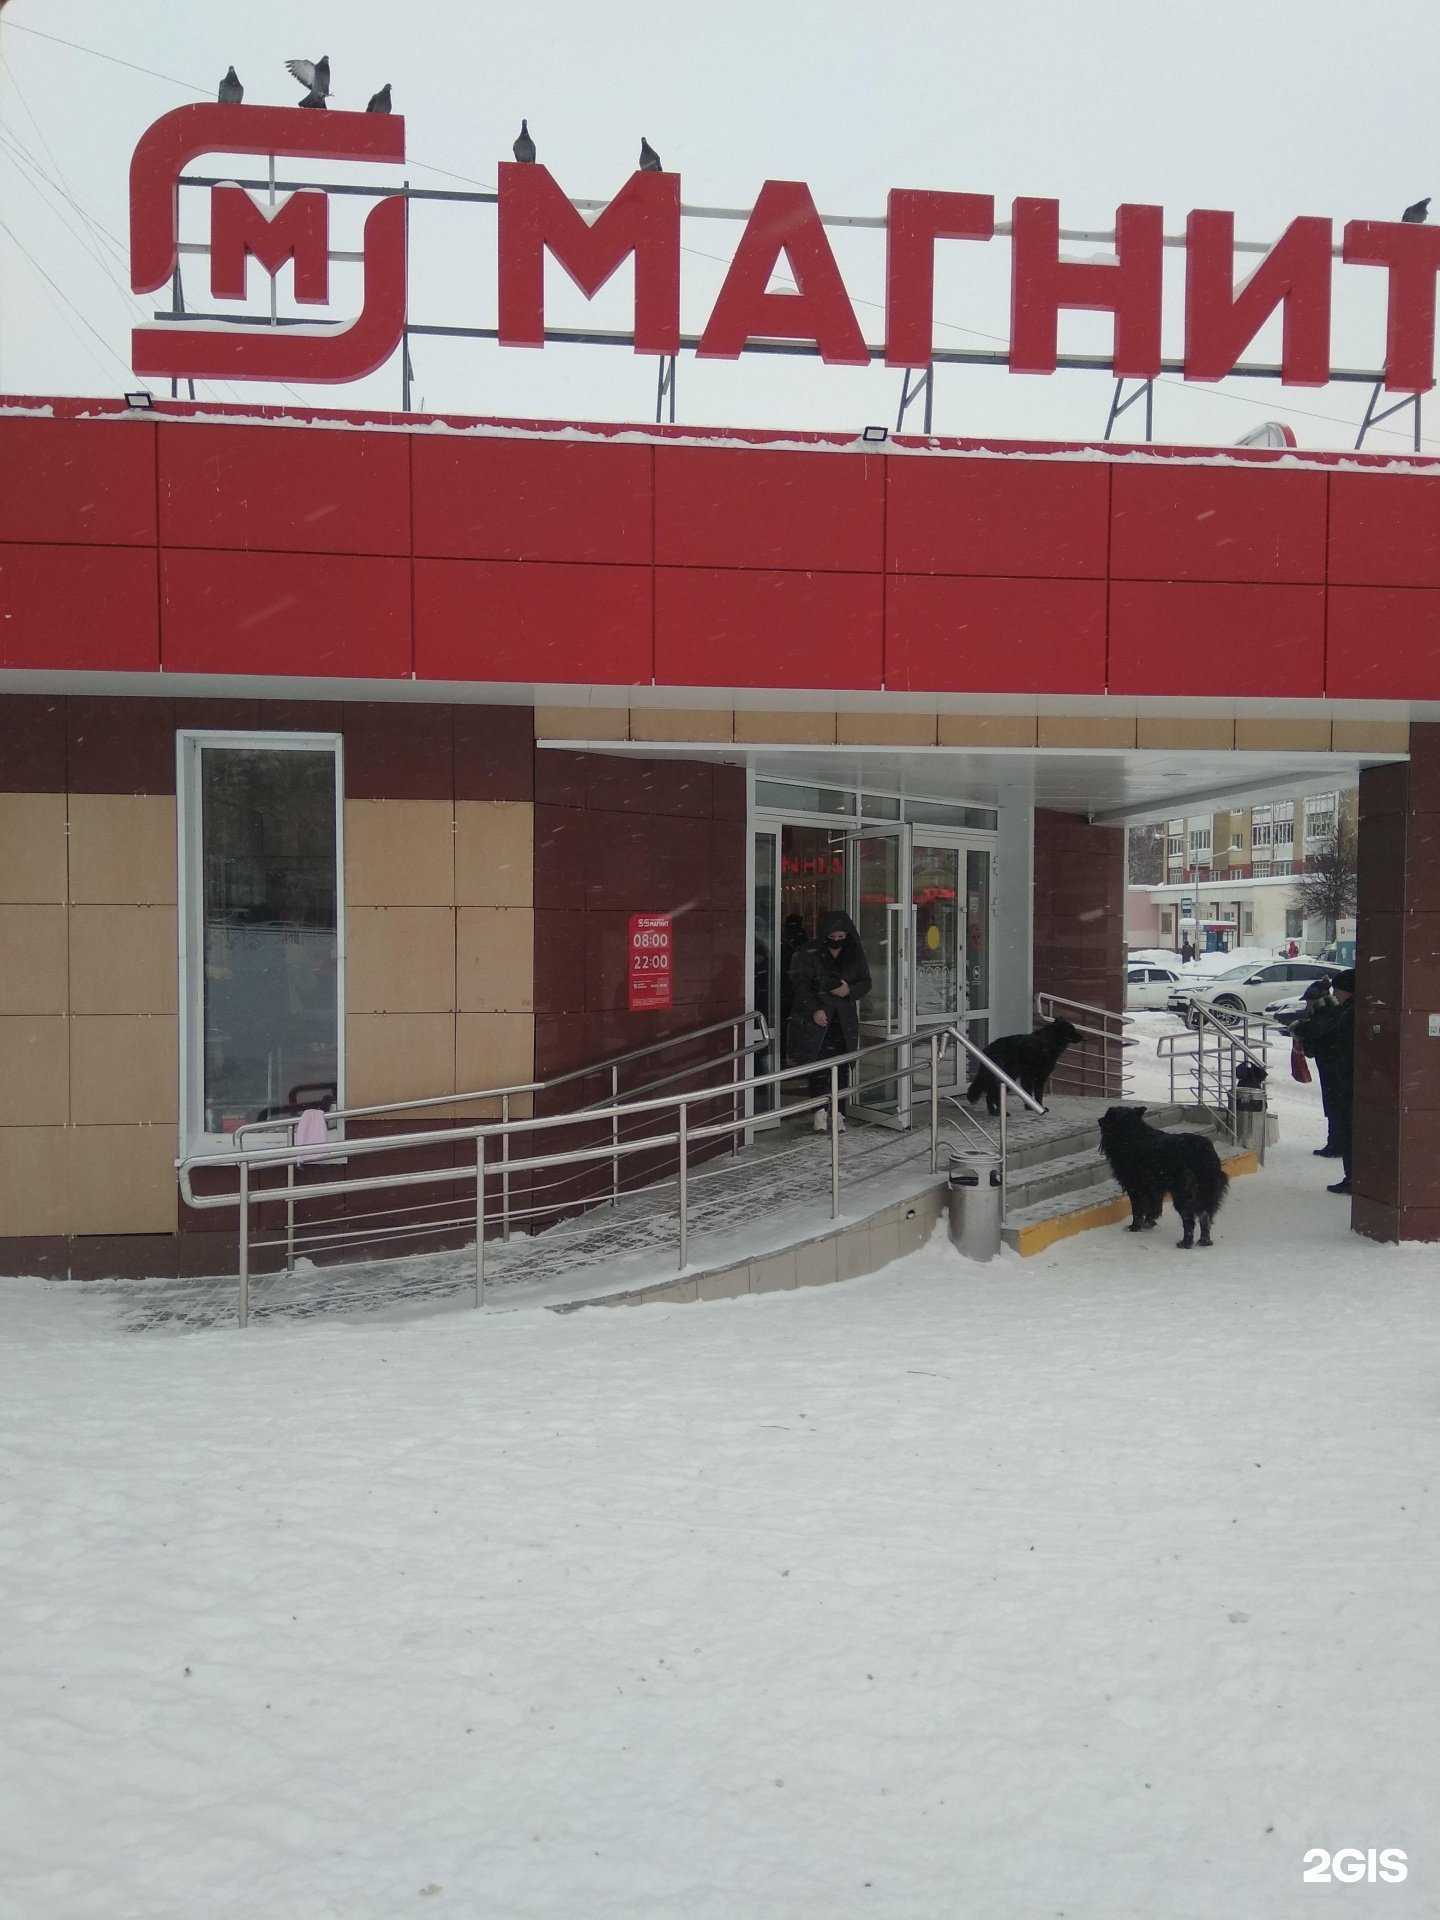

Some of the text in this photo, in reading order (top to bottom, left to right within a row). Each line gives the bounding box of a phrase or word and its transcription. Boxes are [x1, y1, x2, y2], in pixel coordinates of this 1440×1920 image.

[498, 161, 1440, 393] МАГНИТ
[633, 933, 668, 947] 08:00
[633, 955, 668, 969] 22:00
